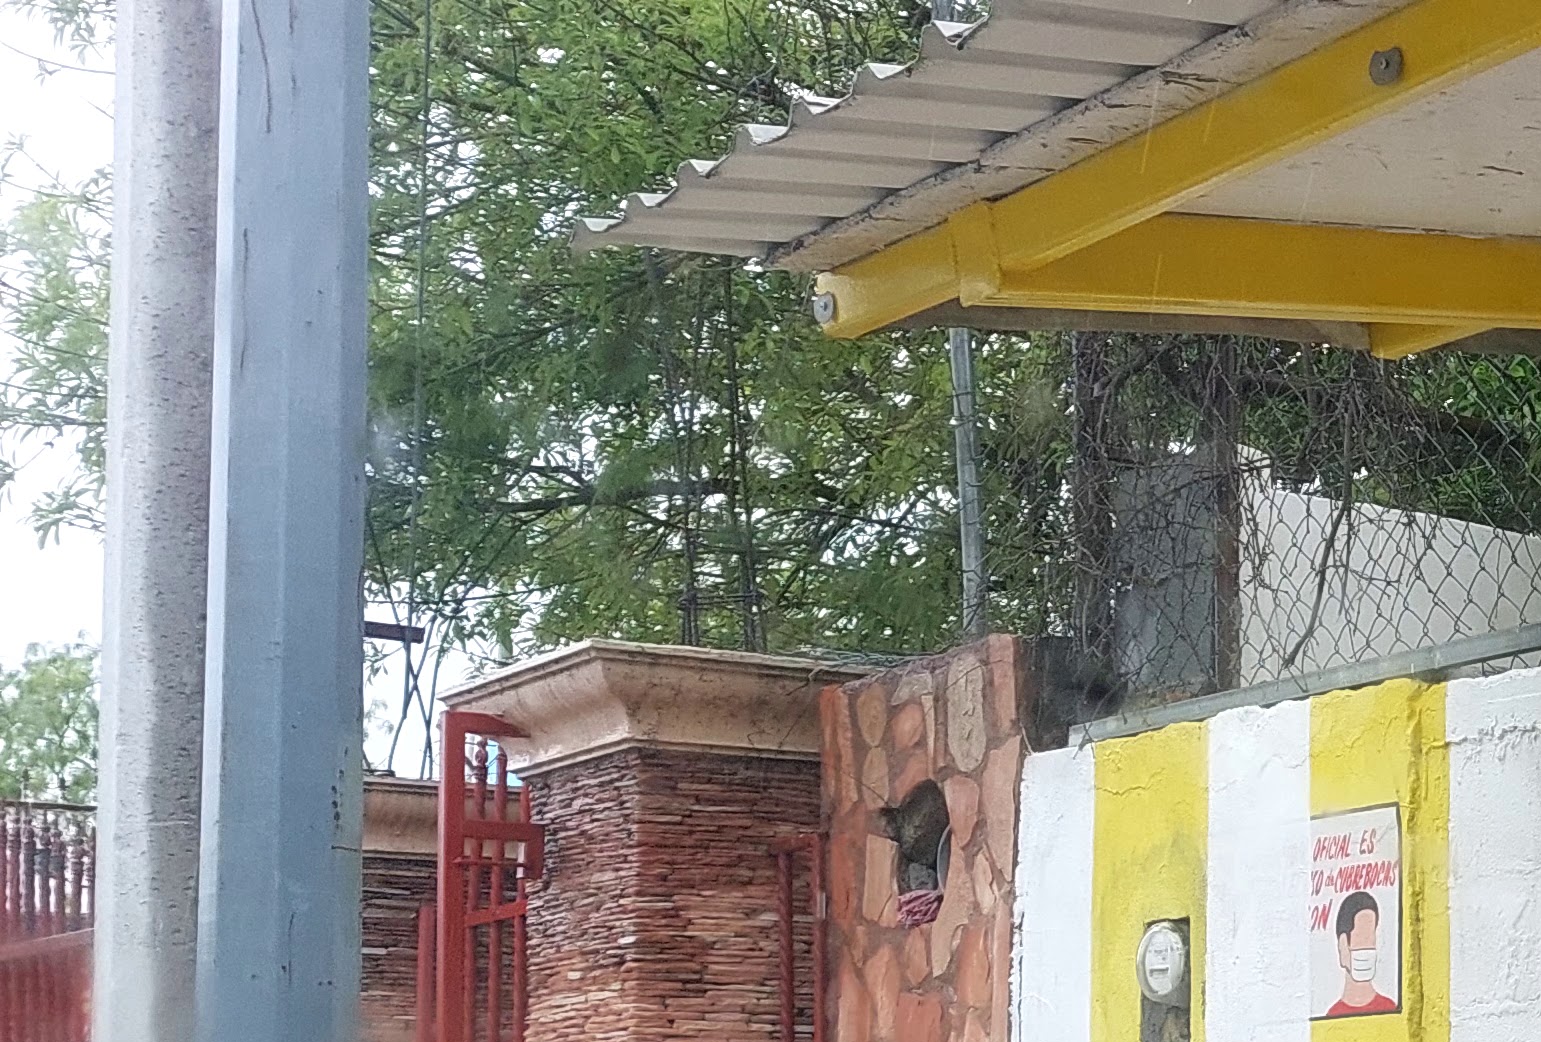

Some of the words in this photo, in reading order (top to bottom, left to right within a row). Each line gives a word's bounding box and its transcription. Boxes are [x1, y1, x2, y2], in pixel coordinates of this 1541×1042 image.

[1313, 833, 1352, 861] OFICIAL
[1360, 828, 1376, 854] ES
[1334, 860, 1399, 894] CUBREBOCAS
